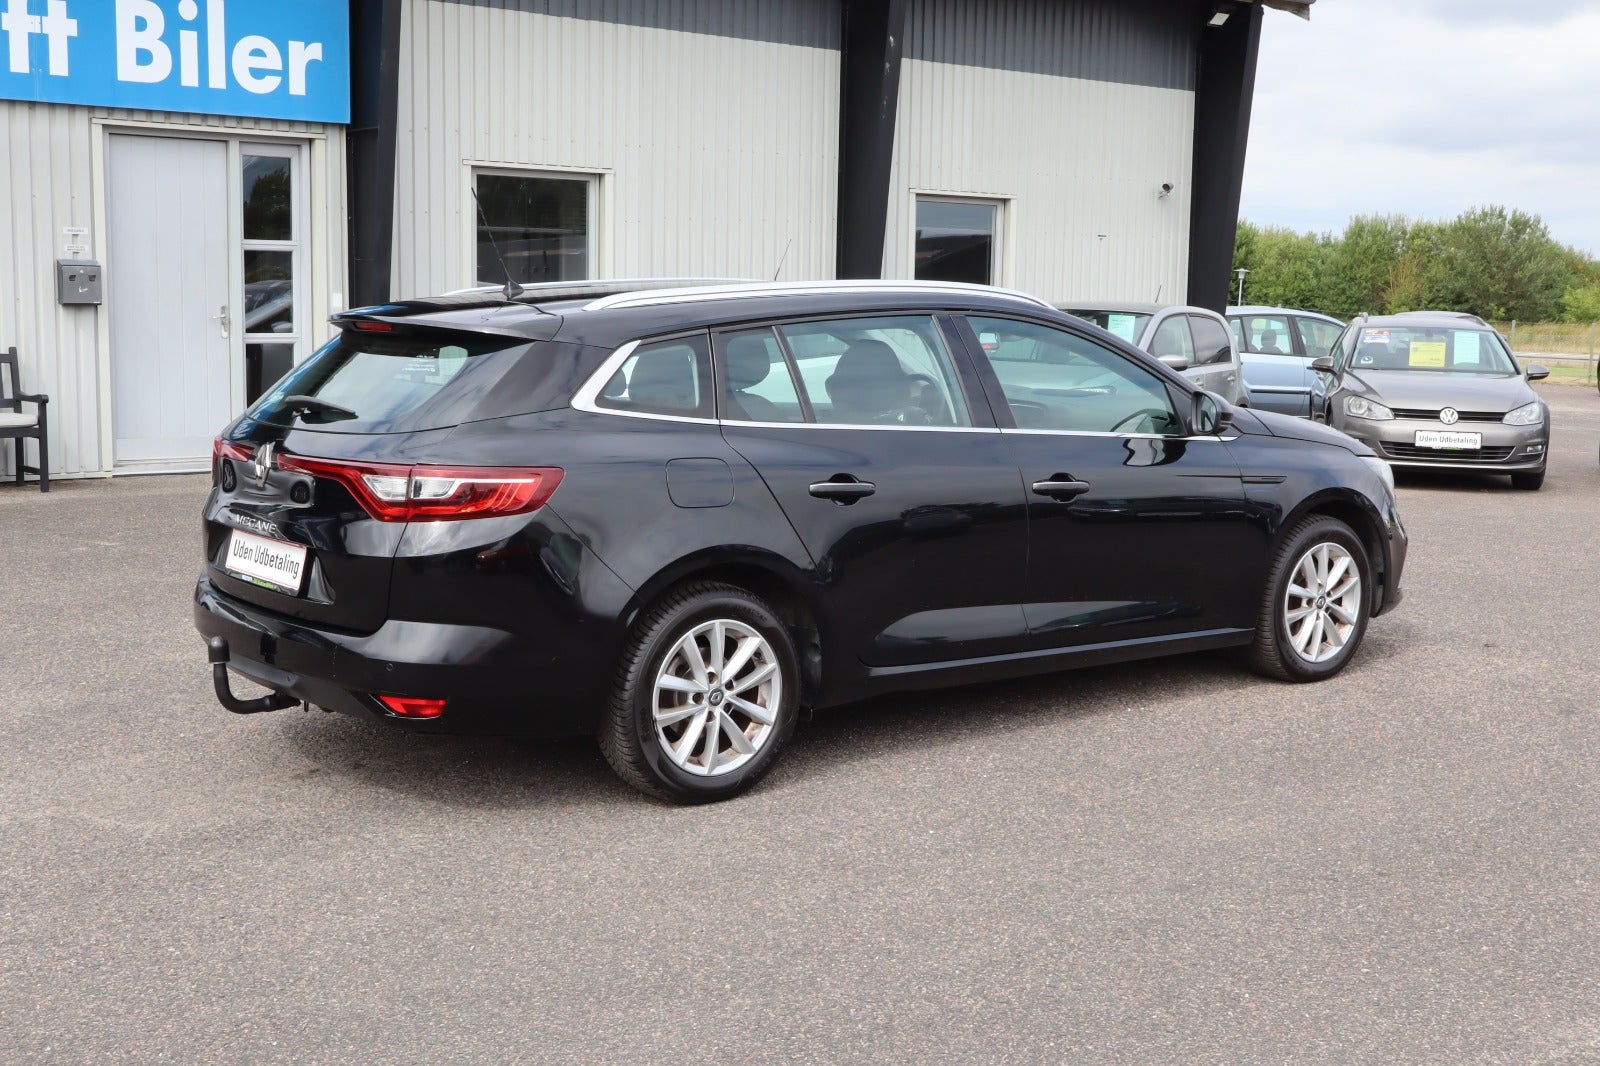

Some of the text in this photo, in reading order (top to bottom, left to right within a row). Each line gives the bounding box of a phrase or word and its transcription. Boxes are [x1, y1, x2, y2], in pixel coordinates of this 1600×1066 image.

[115, 0, 322, 96] Biler
[1440, 435, 1478, 445] Udbetaling
[233, 539, 300, 580] Uden Udbetaling
